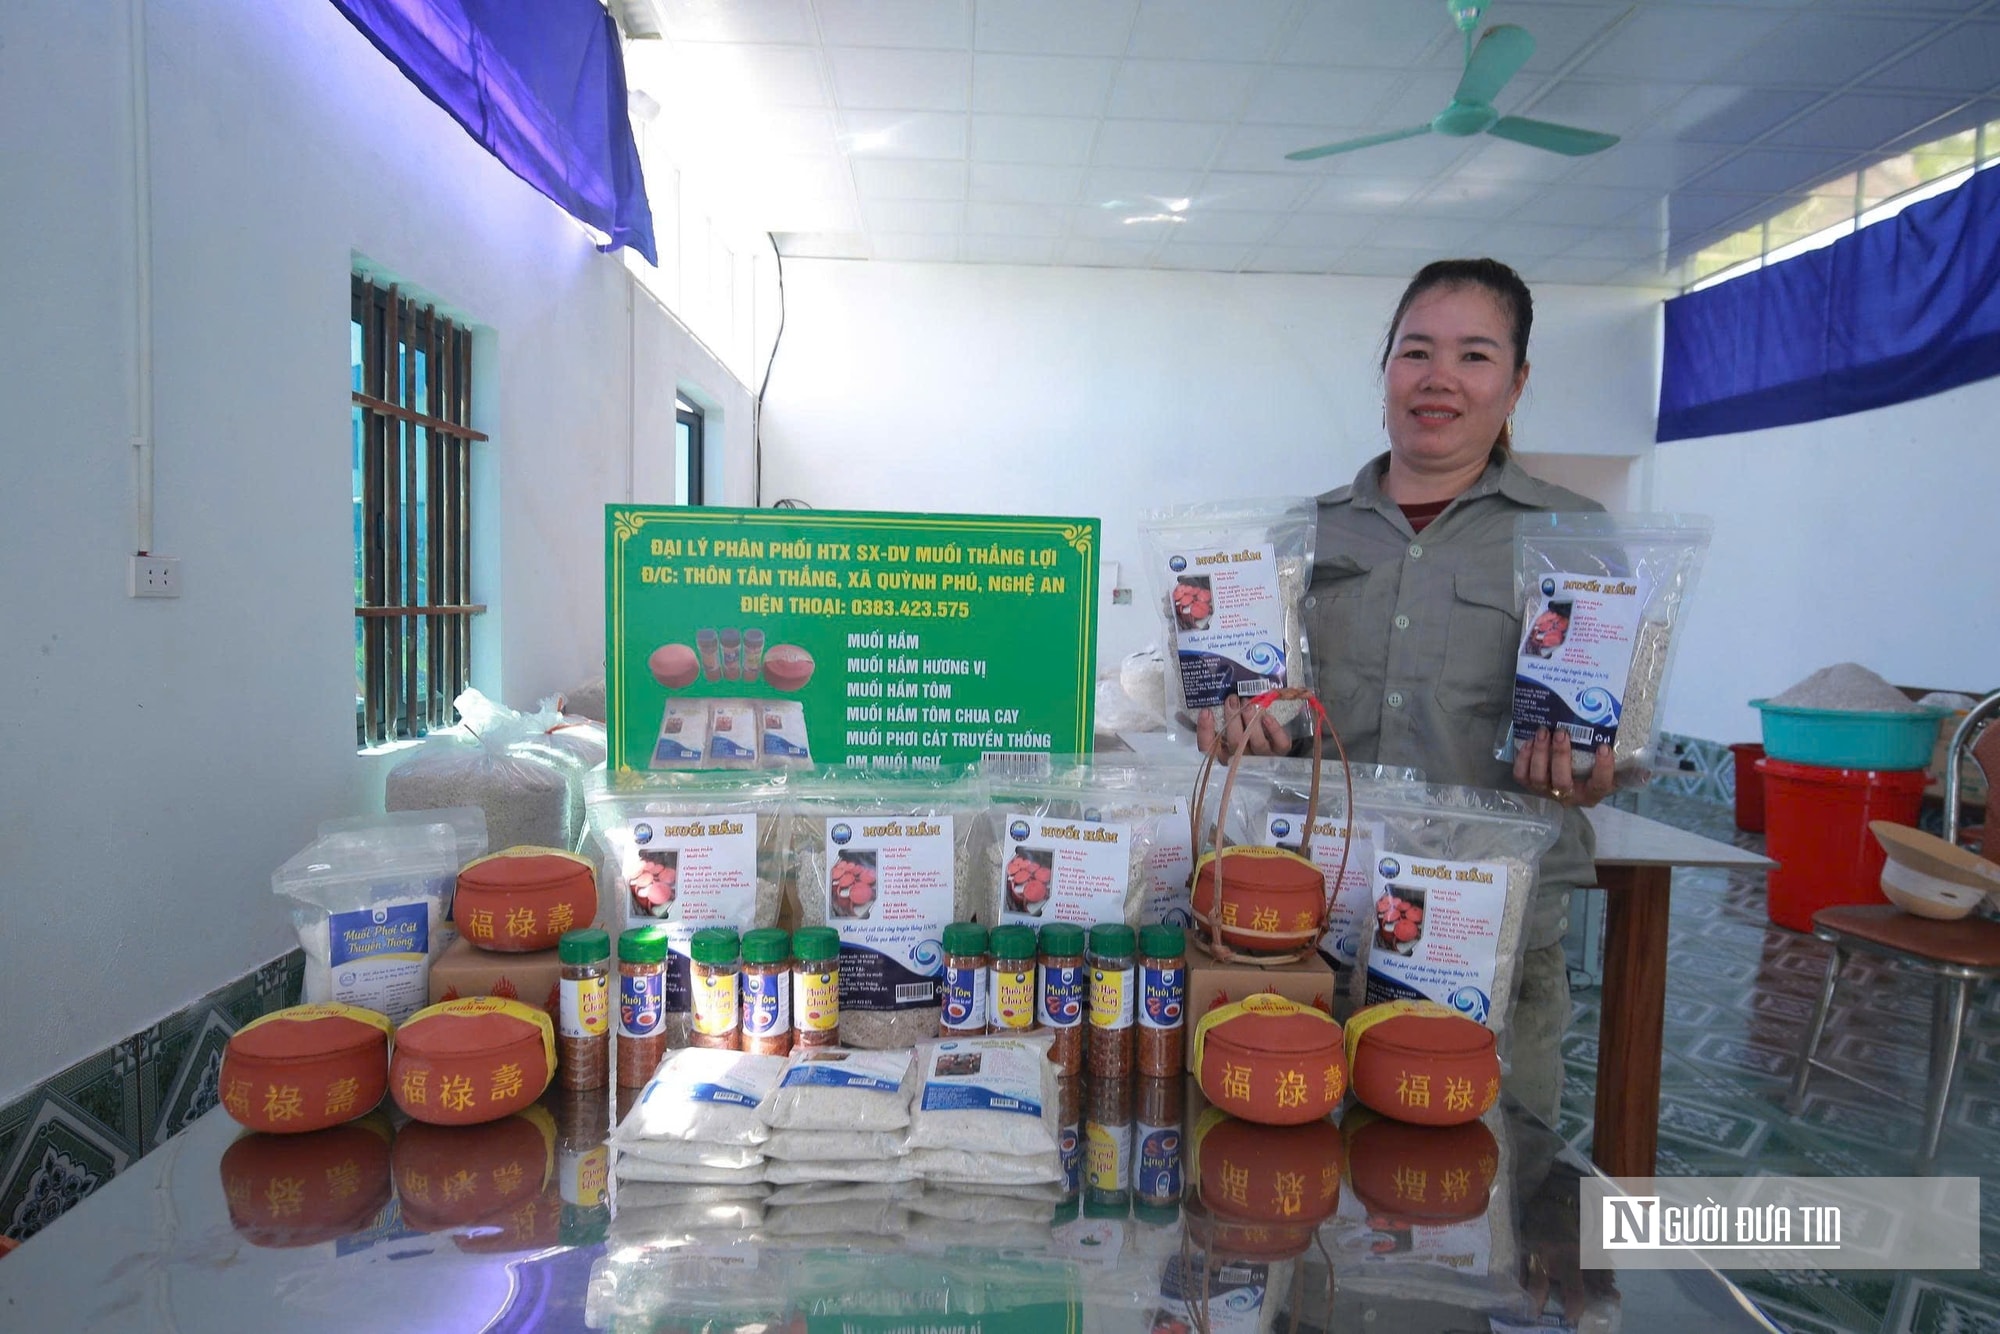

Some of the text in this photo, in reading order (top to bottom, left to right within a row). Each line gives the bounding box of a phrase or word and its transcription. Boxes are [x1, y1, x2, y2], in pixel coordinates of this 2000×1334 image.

[651, 538, 1056, 568] ĐẠI LÝ PHÂN PHỐI HTX SX-DV MUỐI THẮNG LỢI
[642, 566, 1064, 595] Đ/C: THÔN TÂN THẮNG, XÃ QUỲNH PHÚ, NGHỆ AN
[741, 594, 969, 617] ĐIỆN THOẠI: 0383.423.575
[848, 630, 918, 649] MUỐI HẦM
[848, 654, 985, 678] MUỐI HẦM HƯƠNG VỊ
[848, 679, 950, 698] MUỐI HẦM TÔM
[847, 702, 1018, 723] MUỐI HẦM TÔM CHUA CAY
[847, 727, 1050, 747] MUỐI PHƠI CÁT TRUYỀN THỐNG
[665, 819, 744, 837] MUỐI HẦM
[863, 820, 941, 838] MUỐI HẦM
[1041, 825, 1118, 844] MUỐI HẦM
[1411, 863, 1493, 884] MUỐI HẦM
